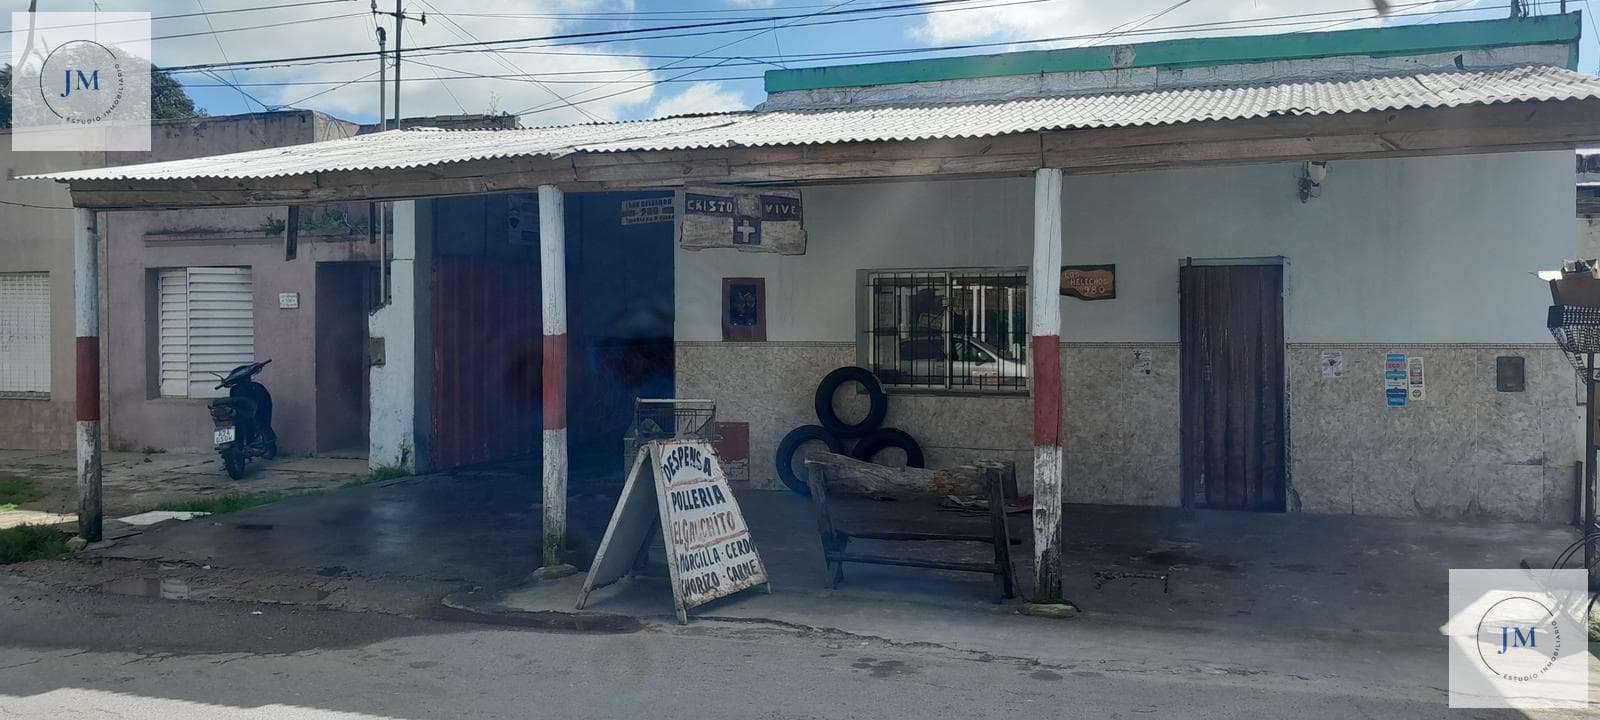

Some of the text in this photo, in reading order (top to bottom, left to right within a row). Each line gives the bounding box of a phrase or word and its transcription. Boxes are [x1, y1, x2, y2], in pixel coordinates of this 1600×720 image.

[687, 200, 733, 213] CRISTO
[766, 203, 797, 215] VIVE
[663, 446, 711, 483] DESPENSA
[671, 485, 726, 512] POLLERIA
[676, 547, 721, 575] MORCILLA
